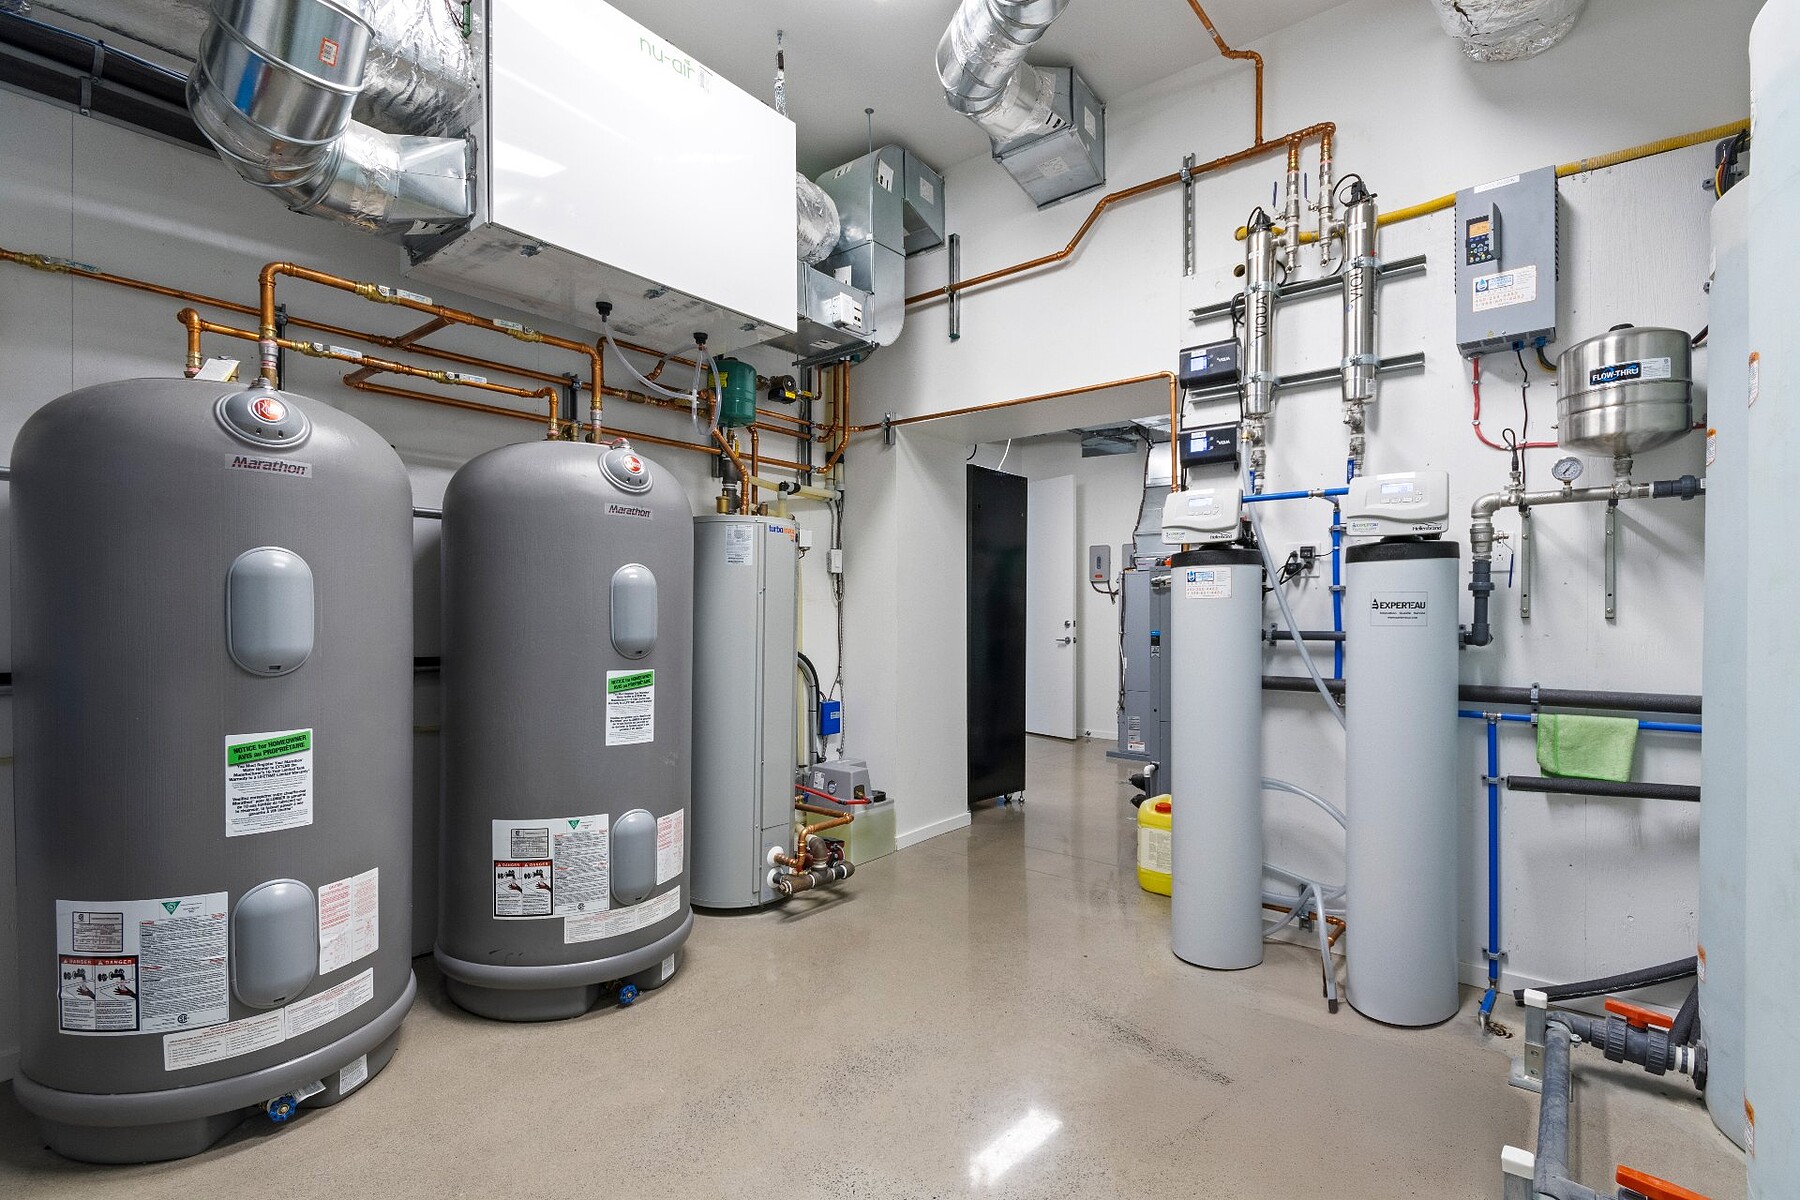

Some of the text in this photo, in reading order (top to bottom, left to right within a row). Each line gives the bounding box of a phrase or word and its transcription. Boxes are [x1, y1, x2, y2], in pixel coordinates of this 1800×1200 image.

[640, 37, 695, 79] nu-air
[1350, 254, 1364, 303] VIQU
[1255, 295, 1268, 339] VIQUA
[1592, 367, 1639, 381] FLOW-THRU
[231, 456, 305, 475] Marathon
[608, 504, 651, 518] Marathon
[1379, 601, 1426, 610] EXPERTEAU
[233, 744, 257, 754] NOTICE
[268, 735, 307, 747] HOMEOWNER
[237, 752, 253, 761] AVIS
